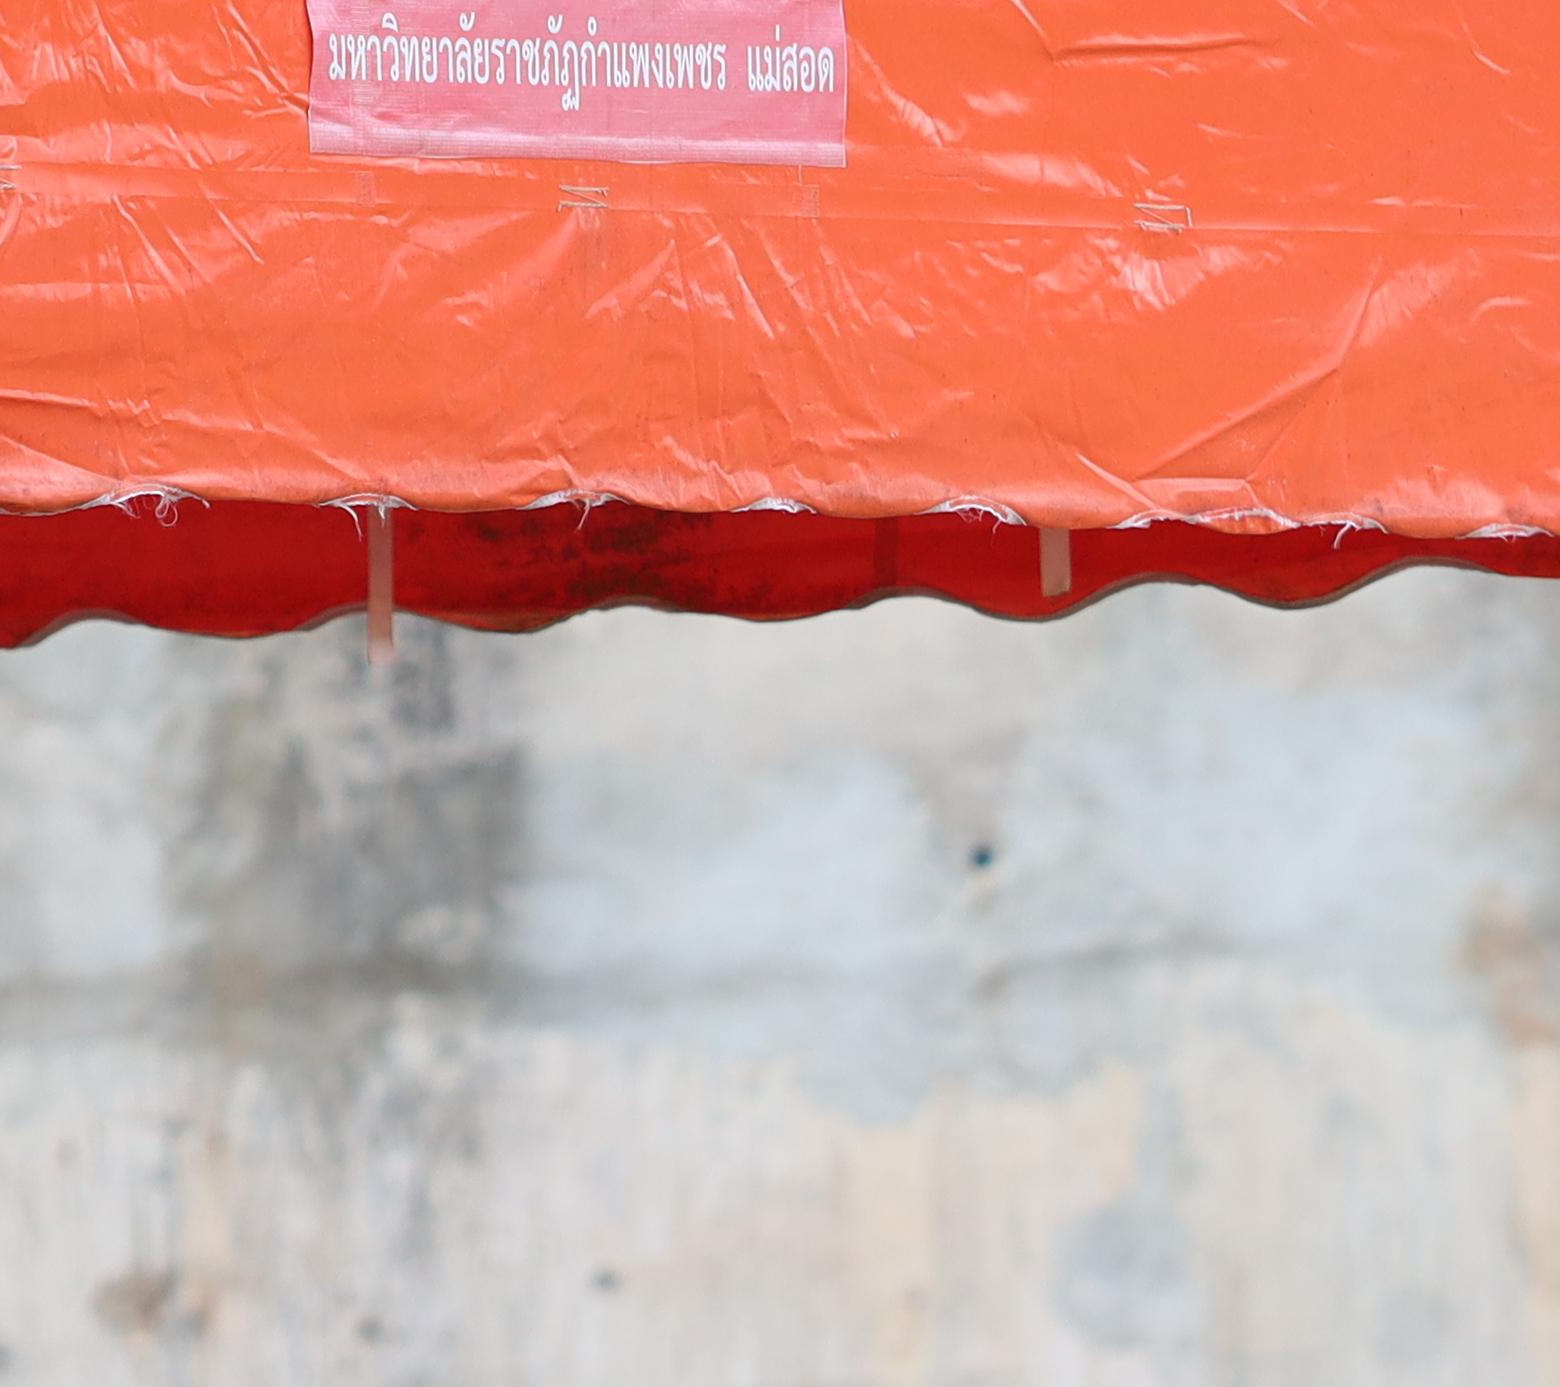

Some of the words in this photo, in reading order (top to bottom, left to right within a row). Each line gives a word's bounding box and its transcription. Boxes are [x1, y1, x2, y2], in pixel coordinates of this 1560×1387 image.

[328, 12, 727, 111] มหาวิทยาลัยราชภัฏกำแพงเพชร
[746, 23, 835, 94] แม่สอด
